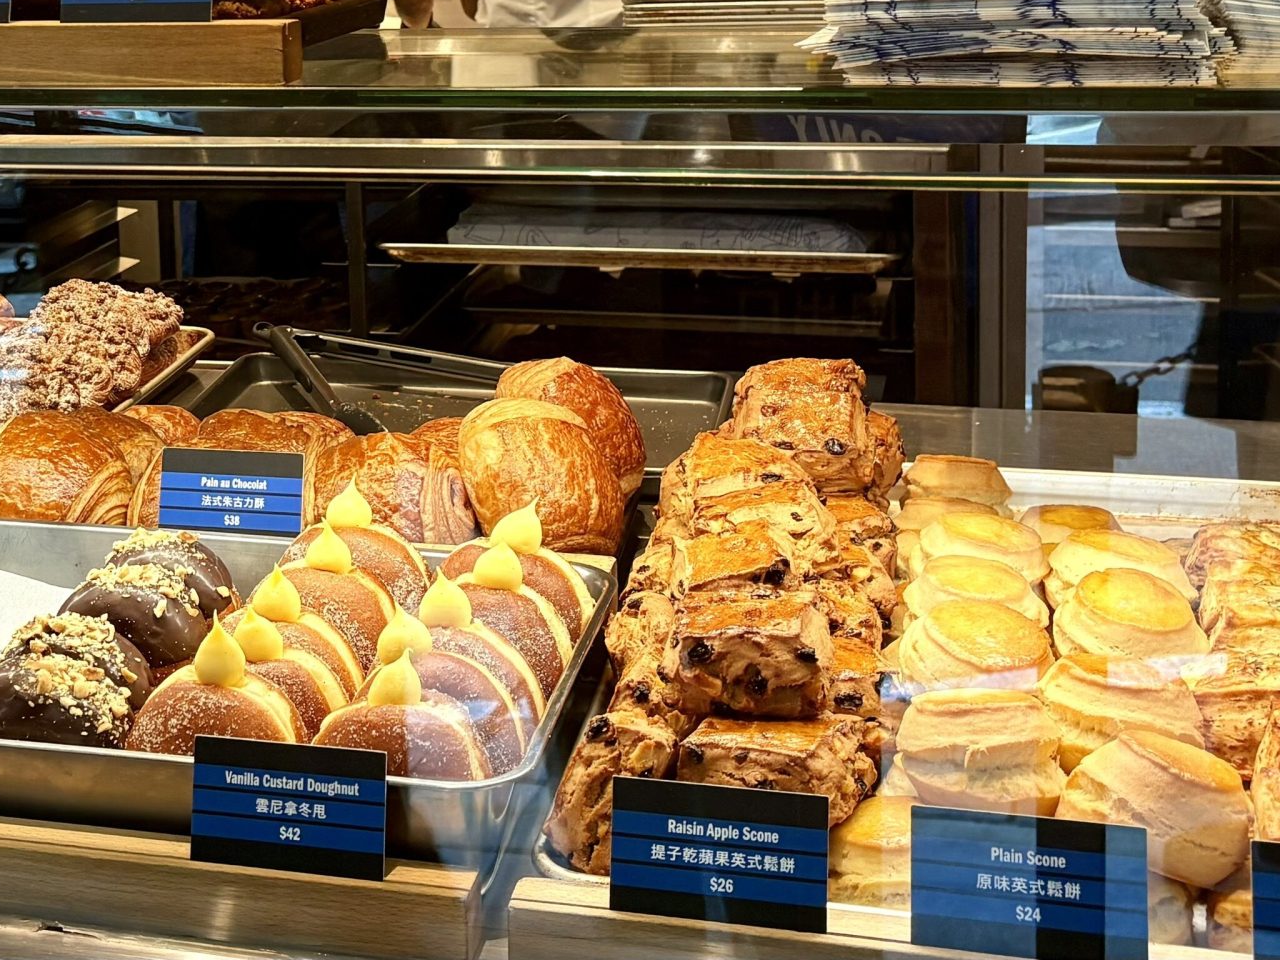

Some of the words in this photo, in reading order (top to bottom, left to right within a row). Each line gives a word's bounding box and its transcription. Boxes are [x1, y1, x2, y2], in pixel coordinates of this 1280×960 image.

[201, 477, 218, 487] Pain
[220, 480, 230, 488] au
[232, 478, 267, 490] Chocolat
[224, 515, 240, 526] $38
[225, 770, 260, 786] Vanilla
[263, 774, 304, 791] Custard
[307, 779, 359, 796] Doughnut
[280, 825, 301, 841] $42
[668, 819, 704, 836] Raisin
[707, 823, 739, 841] Apple
[743, 827, 779, 844] Scone
[651, 844, 795, 874] 提子乾蘋果英式鬆餅
[991, 847, 1023, 864] Plain
[1026, 851, 1067, 869] Scone
[710, 877, 734, 894] $26
[976, 873, 1081, 901] 原味英式鬆餅
[1016, 906, 1041, 922] $24
